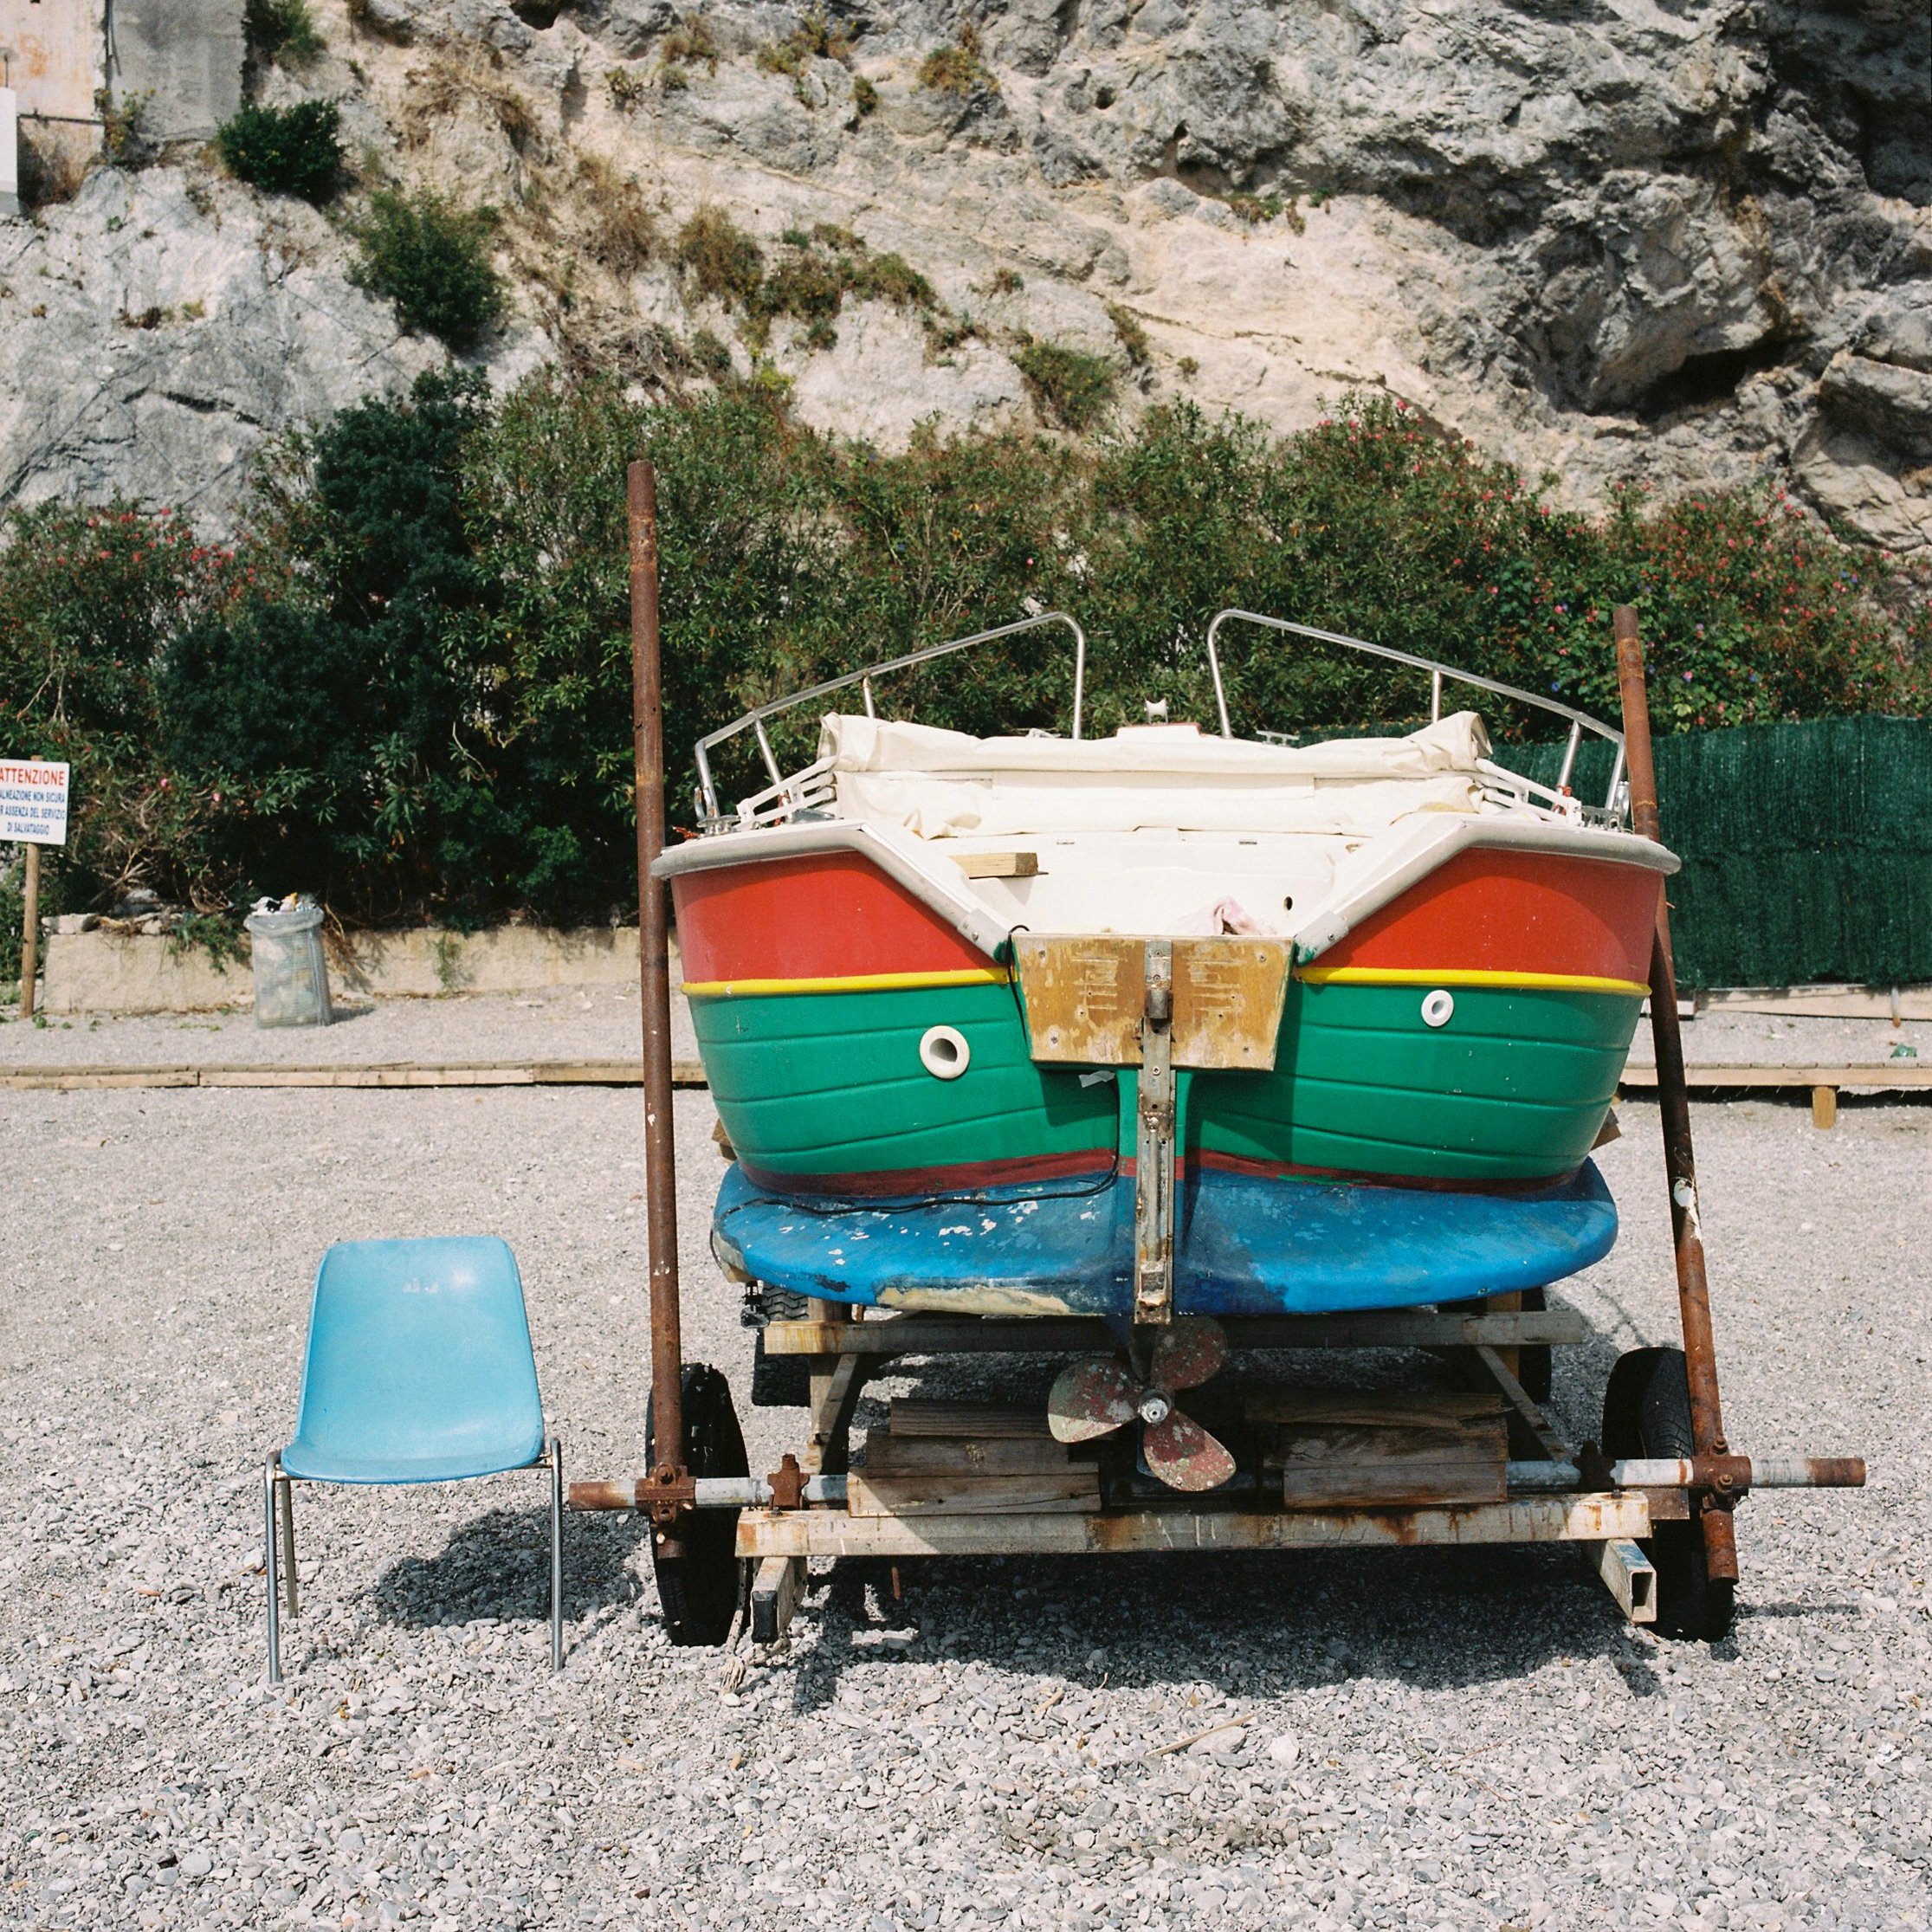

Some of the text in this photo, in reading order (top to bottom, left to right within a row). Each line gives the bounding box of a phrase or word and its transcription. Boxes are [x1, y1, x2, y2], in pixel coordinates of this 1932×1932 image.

[0, 767, 64, 785] ATTENZIONE
[0, 790, 65, 804] ALNEAZIONE NON SICURA
[5, 805, 28, 817] ASSENZA
[30, 807, 39, 817] DEL
[42, 808, 65, 819] SERVIZIO
[7, 822, 49, 835] DI SALVATAGGIO
